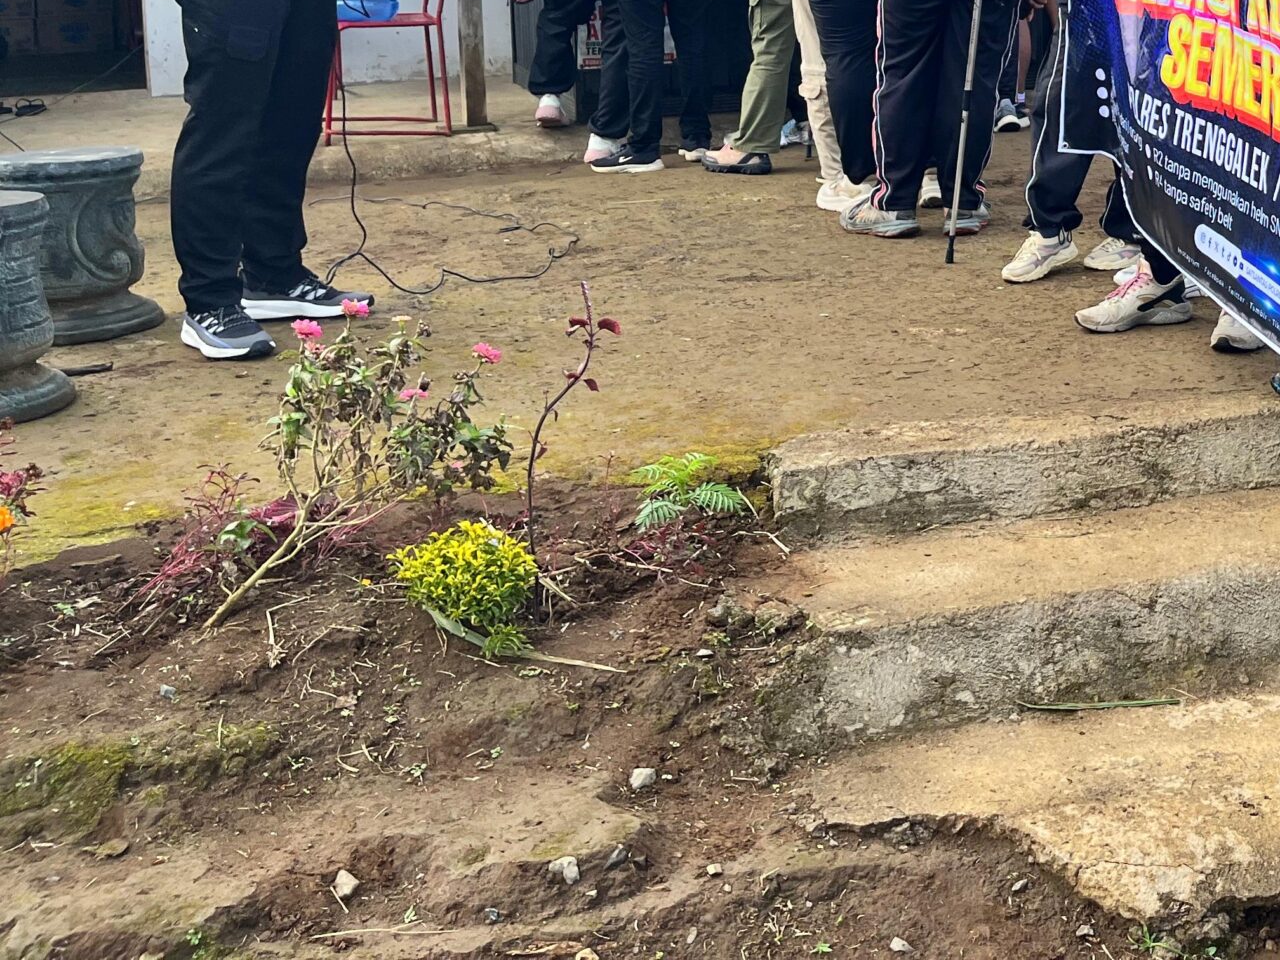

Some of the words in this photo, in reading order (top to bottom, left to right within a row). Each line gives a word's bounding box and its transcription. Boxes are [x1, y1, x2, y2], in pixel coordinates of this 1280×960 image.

[1172, 107, 1271, 195] TRENGGALEK
[1163, 177, 1189, 206] tanpa
[1188, 193, 1218, 226] safety
[1217, 207, 1234, 233] belt
[1164, 154, 1192, 182] tanpa
[1191, 170, 1251, 216] menggunakan
[1250, 199, 1270, 229] helm
